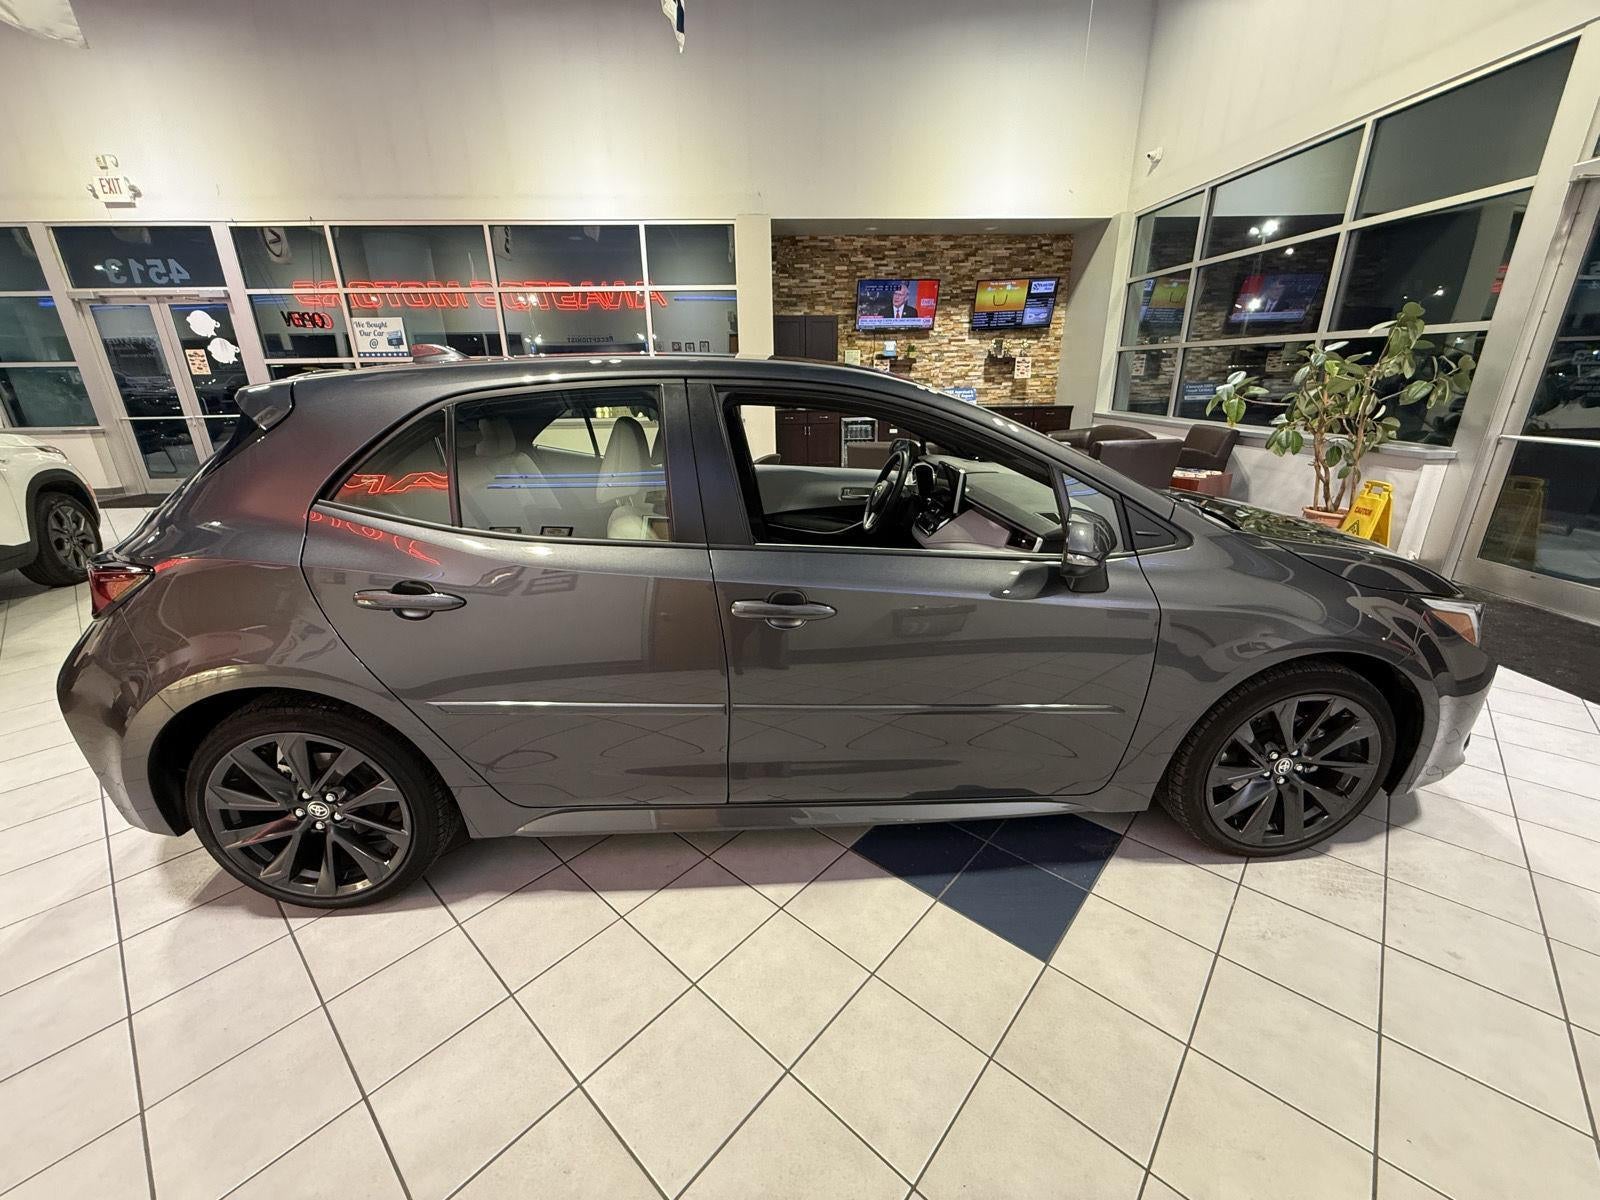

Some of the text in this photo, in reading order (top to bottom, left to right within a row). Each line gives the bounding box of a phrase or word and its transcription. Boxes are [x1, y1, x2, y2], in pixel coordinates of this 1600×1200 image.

[99, 177, 122, 195] EXIT
[366, 321, 388, 329] Bought
[360, 329, 384, 337] Our Car
